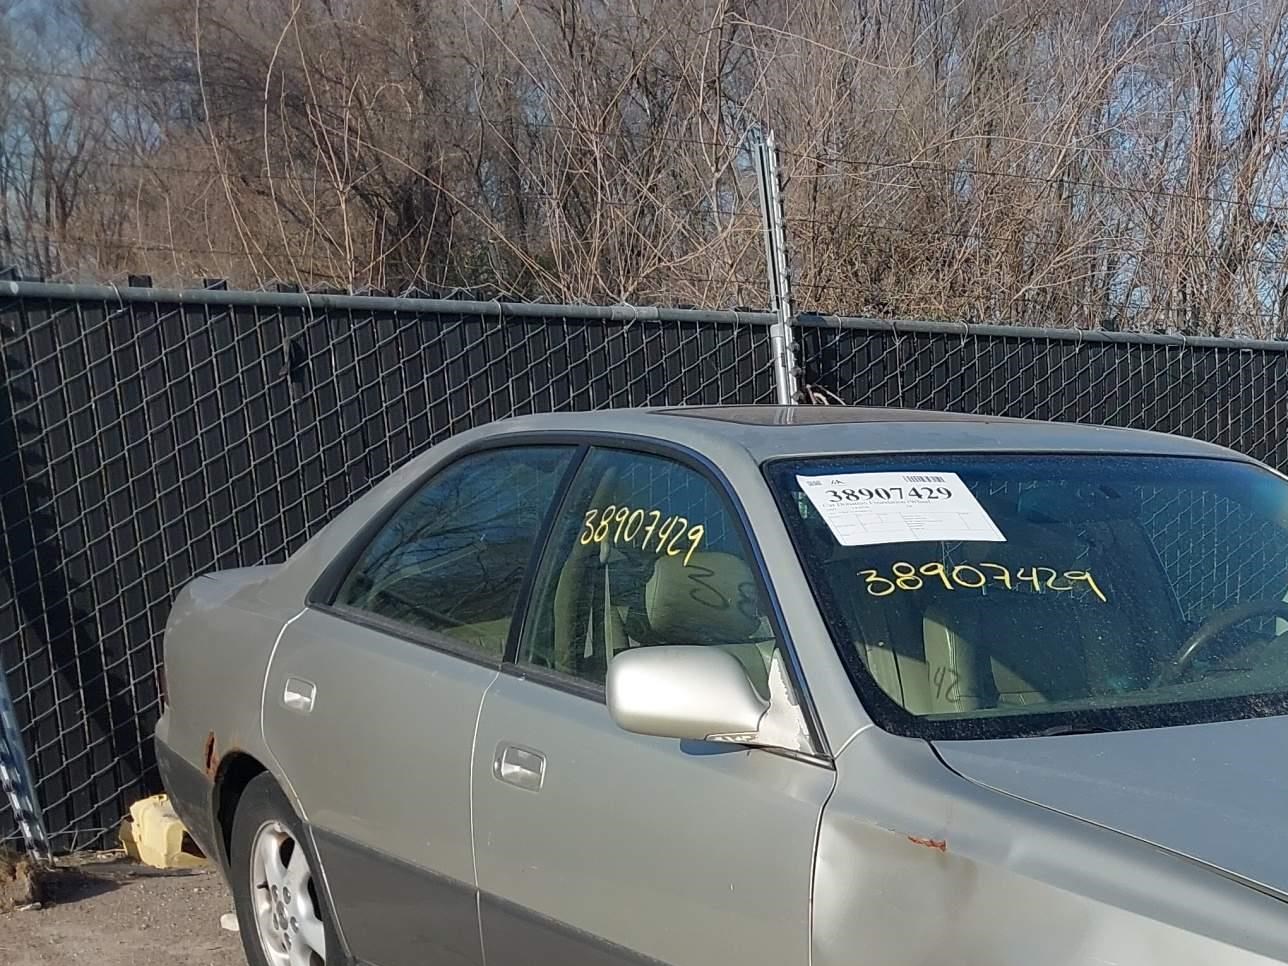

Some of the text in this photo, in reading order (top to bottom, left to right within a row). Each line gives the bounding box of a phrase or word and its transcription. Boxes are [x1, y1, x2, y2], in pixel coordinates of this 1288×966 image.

[825, 486, 953, 503] 38907429
[580, 505, 704, 567] 38907429
[857, 562, 1107, 602] 38907429
